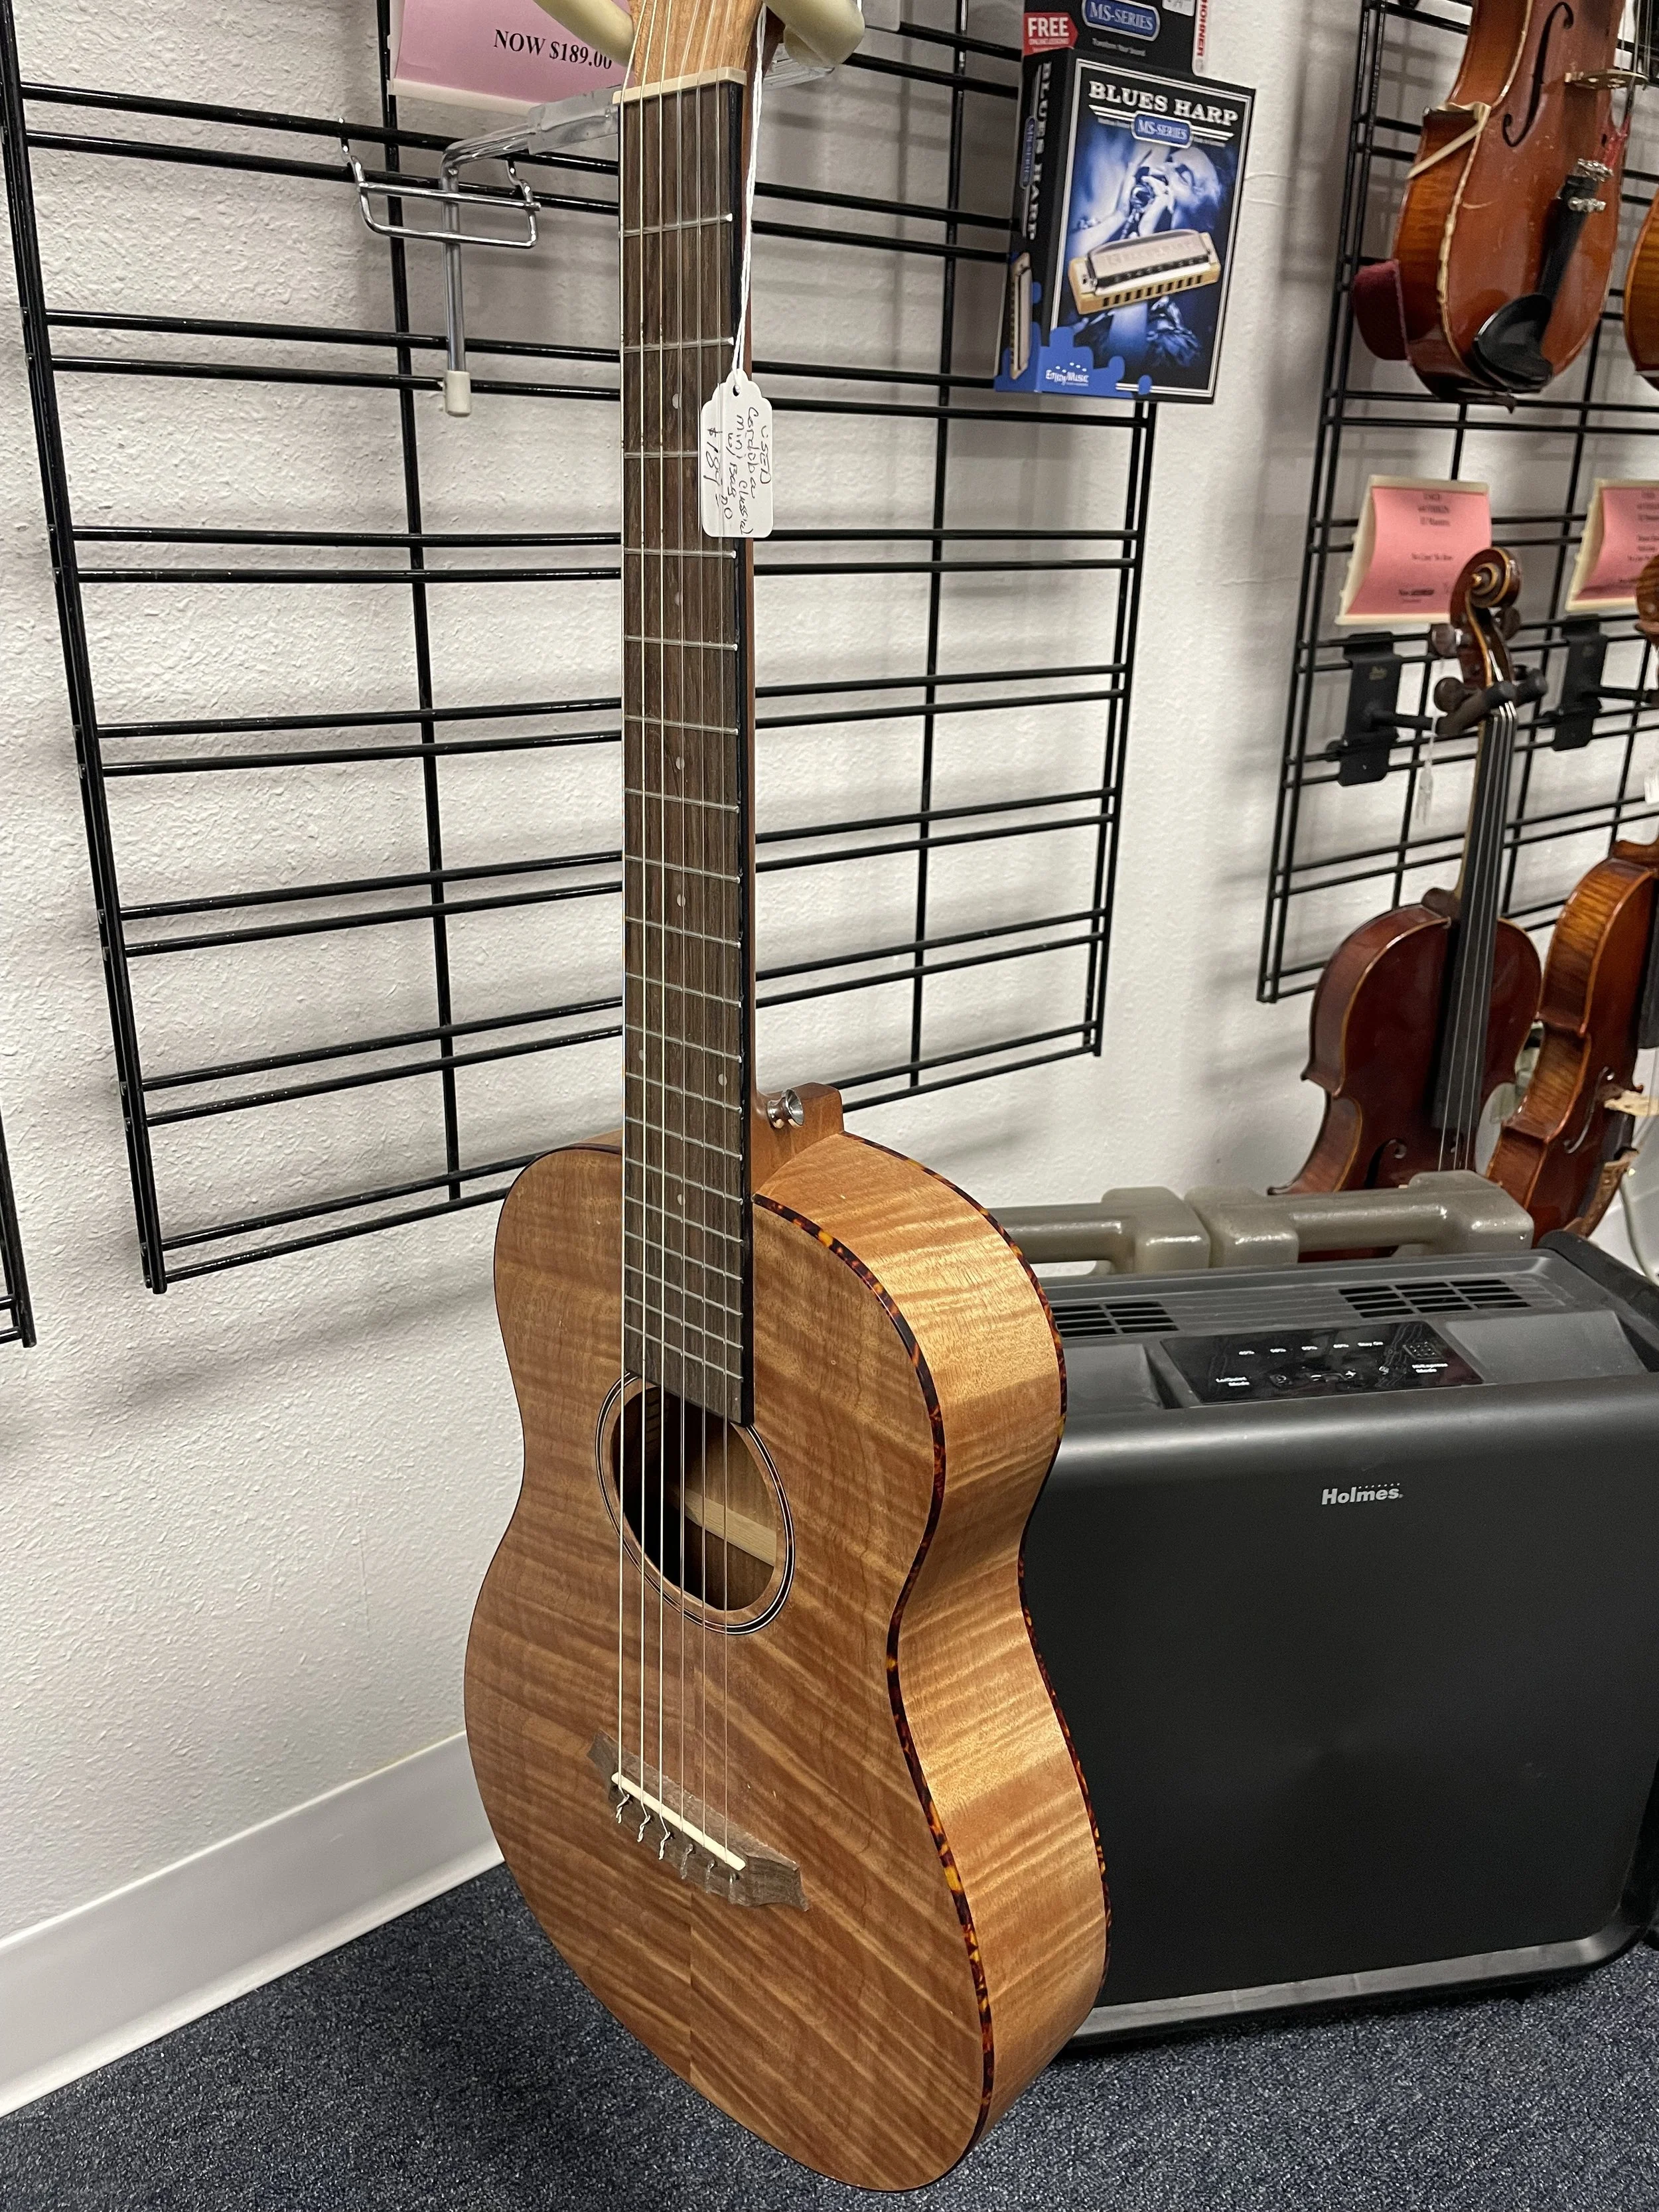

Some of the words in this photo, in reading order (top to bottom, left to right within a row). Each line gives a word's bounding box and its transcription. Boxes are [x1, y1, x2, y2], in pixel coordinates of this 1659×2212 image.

[1027, 17, 1070, 37] FREE
[1090, 1, 1154, 31] MS-SERIES
[493, 29, 546, 56] NOW
[549, 41, 612, 70] $189.00
[1088, 80, 1169, 113] BLUES
[1173, 99, 1238, 126] HARP
[1137, 119, 1188, 140] MS-SERIES
[760, 425, 772, 484] USED
[1321, 1486, 1400, 1505] Holmes
